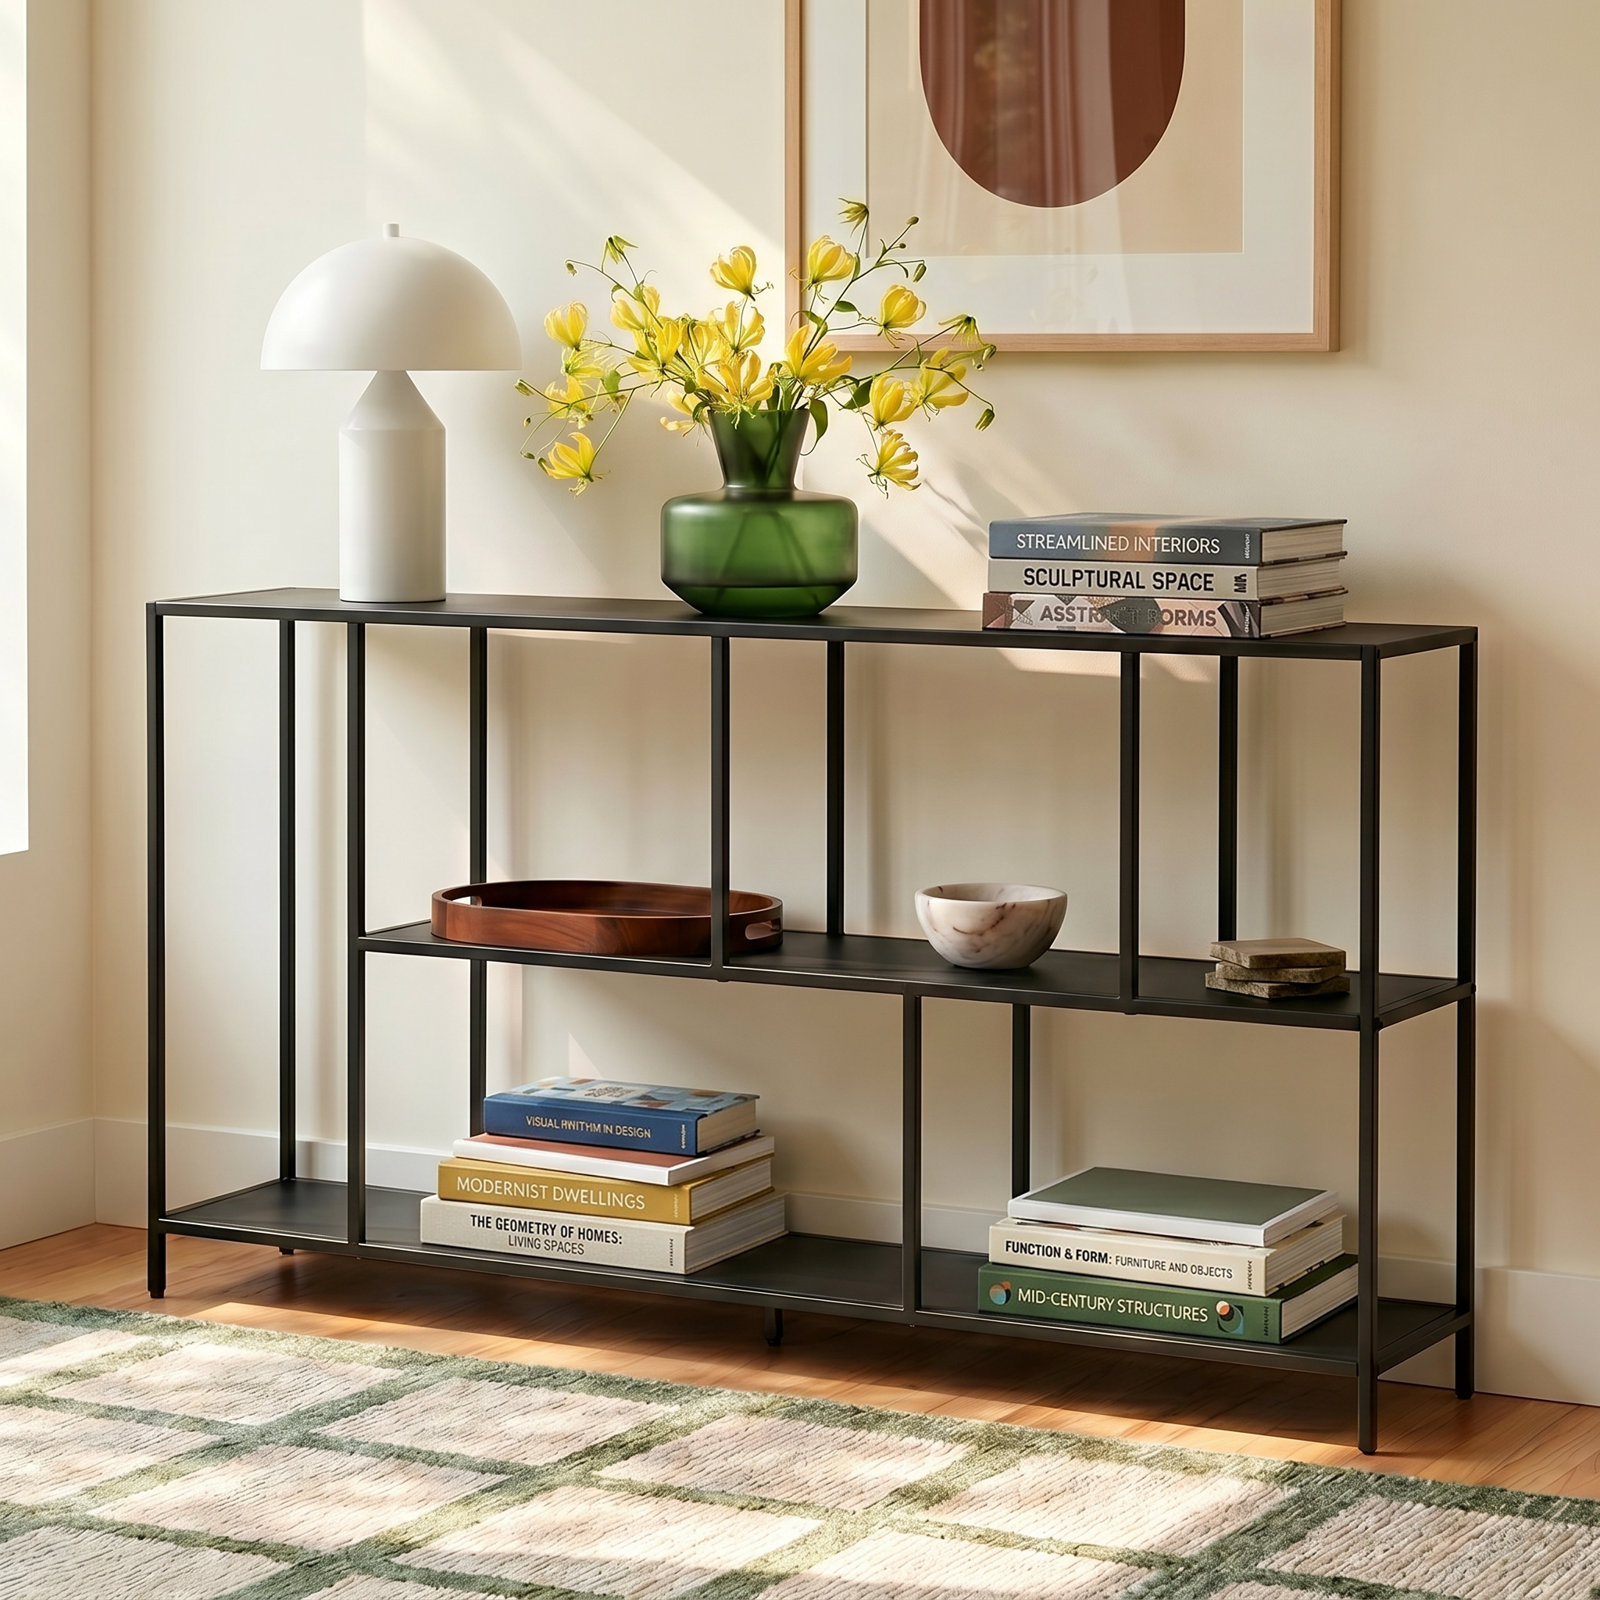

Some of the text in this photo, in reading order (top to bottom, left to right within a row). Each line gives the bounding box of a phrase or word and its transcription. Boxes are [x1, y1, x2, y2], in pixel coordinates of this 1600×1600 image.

[1016, 533, 1130, 552] STREAMLINED
[1133, 536, 1221, 554] INTERIORS
[1023, 567, 1146, 590] SCULPTURAL
[1152, 571, 1215, 592] SPACE
[526, 1115, 560, 1130] VISUAL
[615, 1124, 652, 1139] DESIGN
[456, 1176, 549, 1200] MODERNIST
[552, 1185, 646, 1210] DWELLINGS
[470, 1214, 623, 1245] THE GEOMETRY OF HOMES:
[508, 1234, 585, 1255] LIVING SPACES
[1004, 1240, 1062, 1258] FUNCTION
[1064, 1246, 1073, 1260] &
[1075, 1248, 1112, 1265] FORM:
[1115, 1255, 1167, 1271] FURNITURE
[1168, 1261, 1189, 1274] AND
[1190, 1263, 1233, 1279] OBJECTS
[1018, 1288, 1209, 1323] MID-CENTURY STRUCTURES
